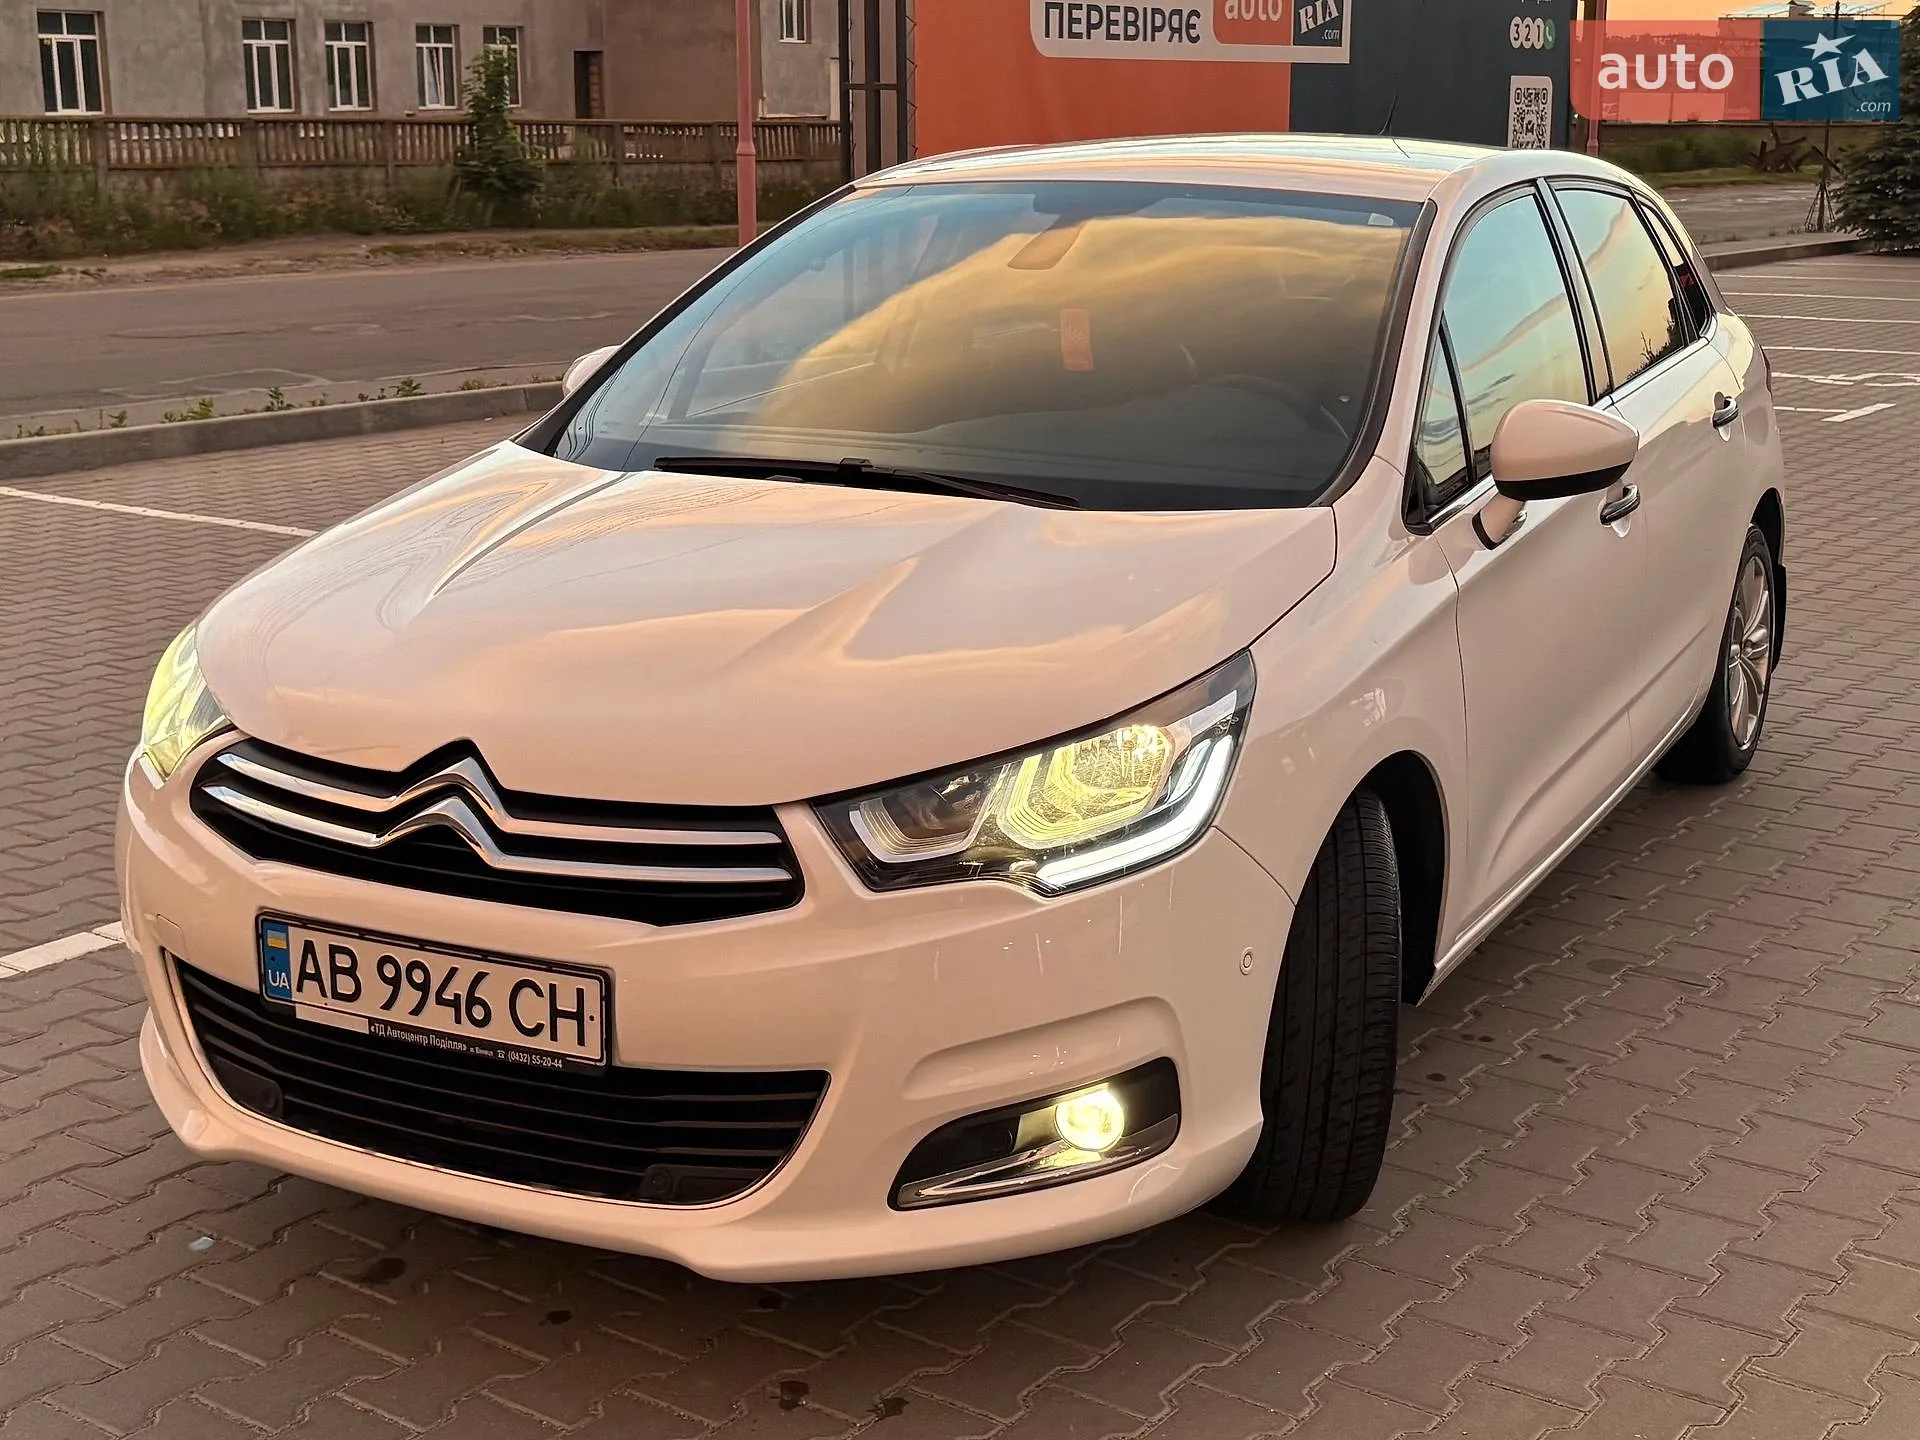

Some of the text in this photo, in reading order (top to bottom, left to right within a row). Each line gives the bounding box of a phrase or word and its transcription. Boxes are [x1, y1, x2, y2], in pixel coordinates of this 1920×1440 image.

[1043, 1, 1201, 44] ПЕРЕВІРЯЄ
[1298, 0, 1339, 34] RIA
[1513, 23, 1542, 42] 321
[267, 968, 290, 990] UA
[295, 938, 587, 1048] AB 9946 CH
[386, 1024, 429, 1045] Автоцентр
[531, 1055, 563, 1069] 55-20-44
